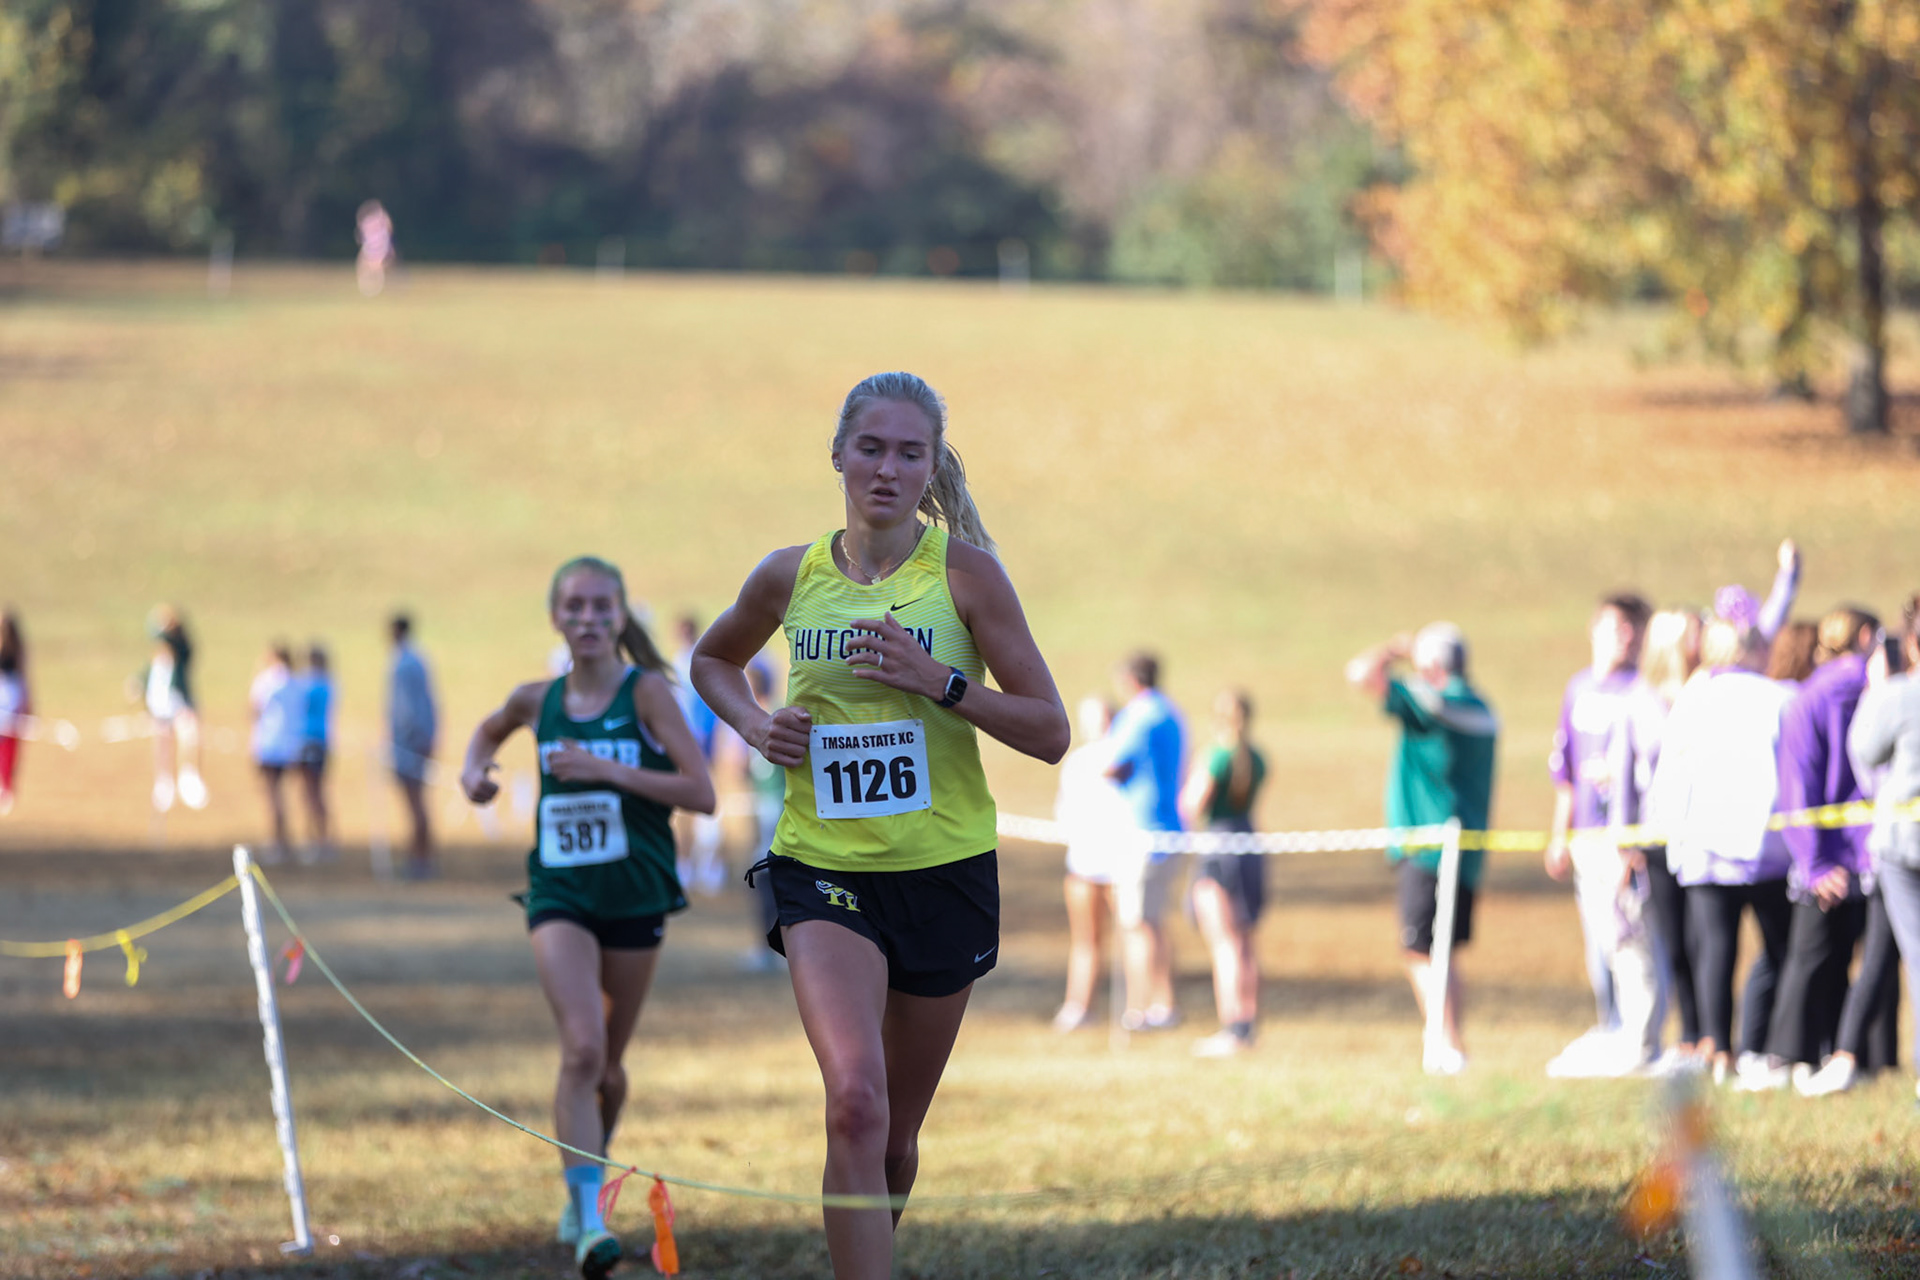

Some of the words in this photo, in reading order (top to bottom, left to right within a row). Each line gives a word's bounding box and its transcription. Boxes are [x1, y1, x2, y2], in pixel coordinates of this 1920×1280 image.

[822, 736, 860, 749] TMSAA
[862, 733, 896, 748] STATE
[898, 731, 914, 745] XC
[823, 756, 917, 803] 1126
[556, 819, 607, 852] 587
